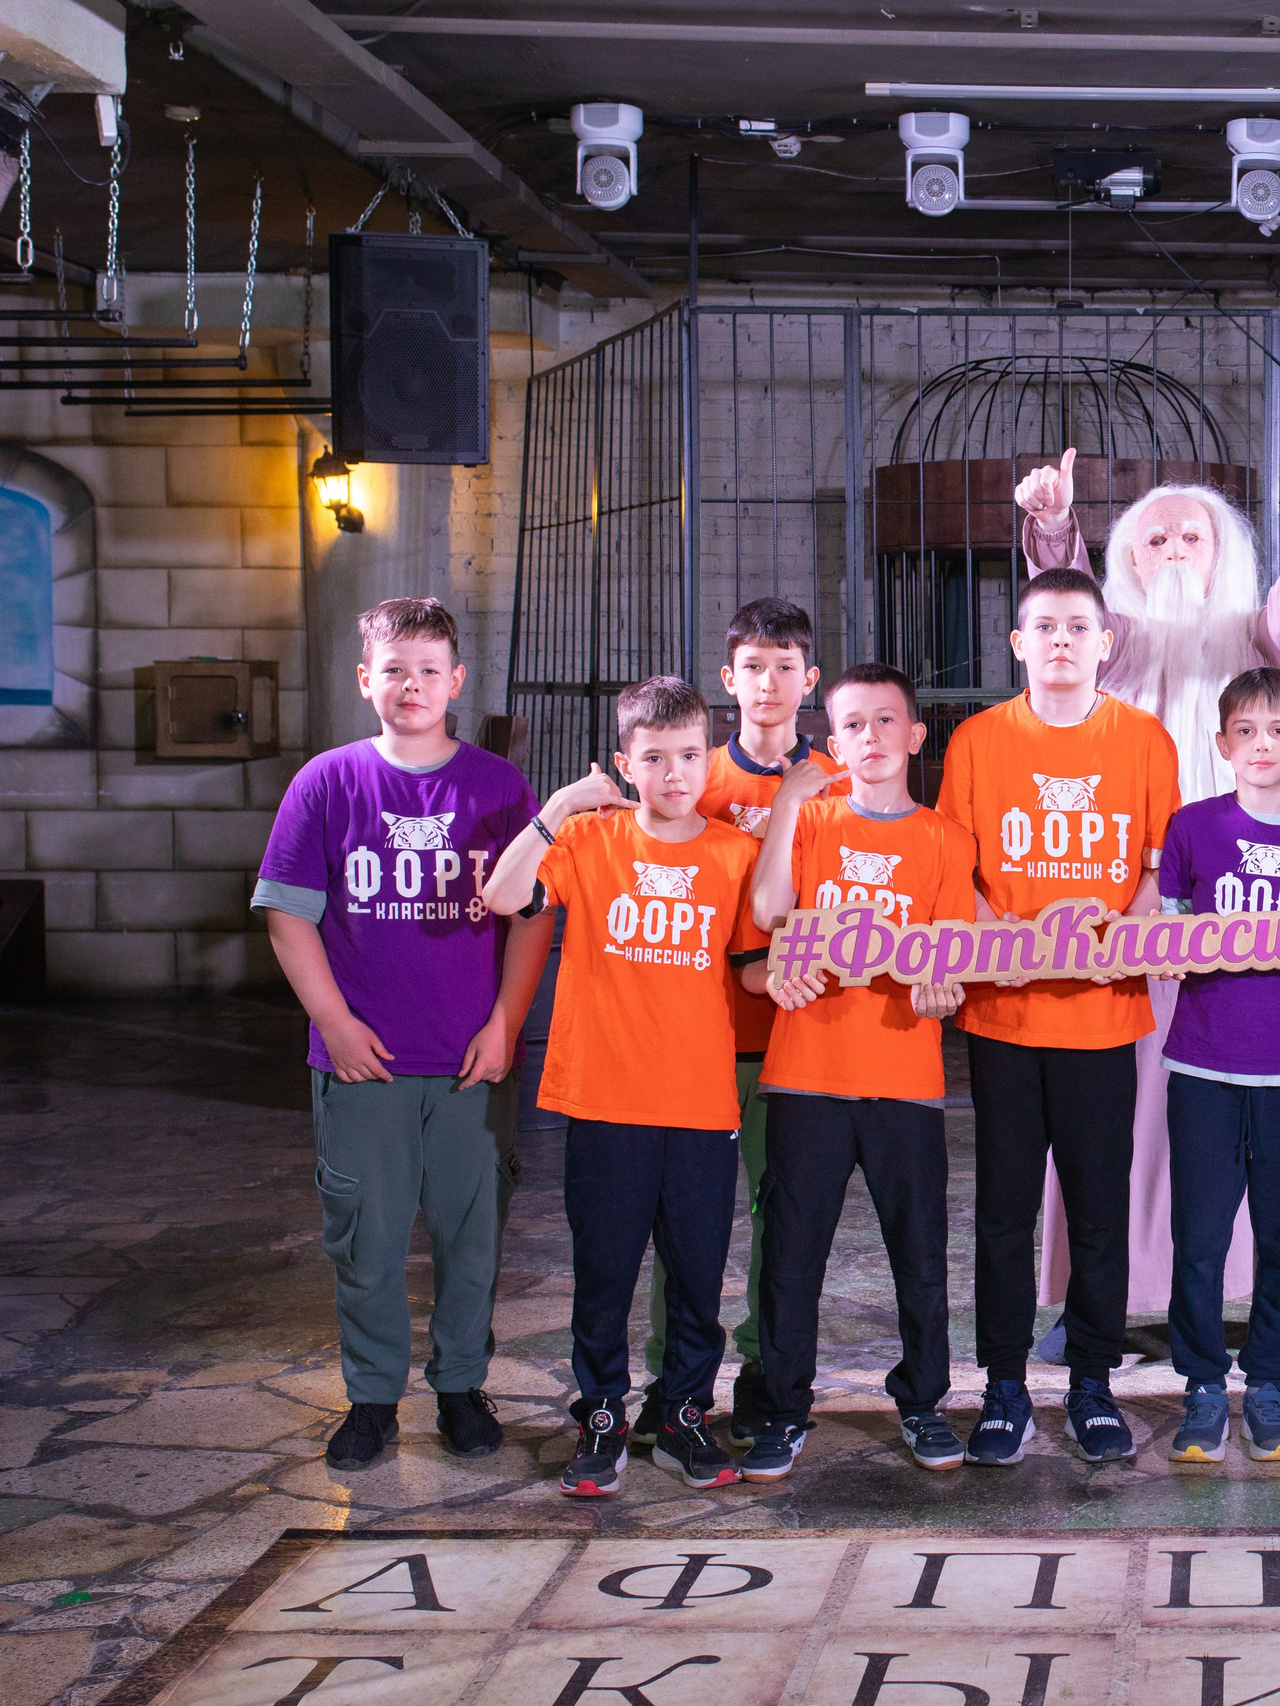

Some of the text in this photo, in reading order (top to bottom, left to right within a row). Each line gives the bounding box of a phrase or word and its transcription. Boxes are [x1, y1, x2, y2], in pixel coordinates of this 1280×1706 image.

[1000, 807, 1132, 861] ФОРТ
[345, 845, 489, 902] ФОРТ
[1027, 861, 1102, 879] КЛАССИК
[376, 902, 460, 920] КЛАССИК
[606, 893, 716, 948] ФОРТ
[625, 946, 690, 966] КЛАССИК
[979, 1419, 1014, 1433] PUMA
[1085, 1416, 1120, 1430] PUMA
[280, 1553, 457, 1612] А
[597, 1553, 775, 1610] Ф
[893, 1552, 1076, 1609] П
